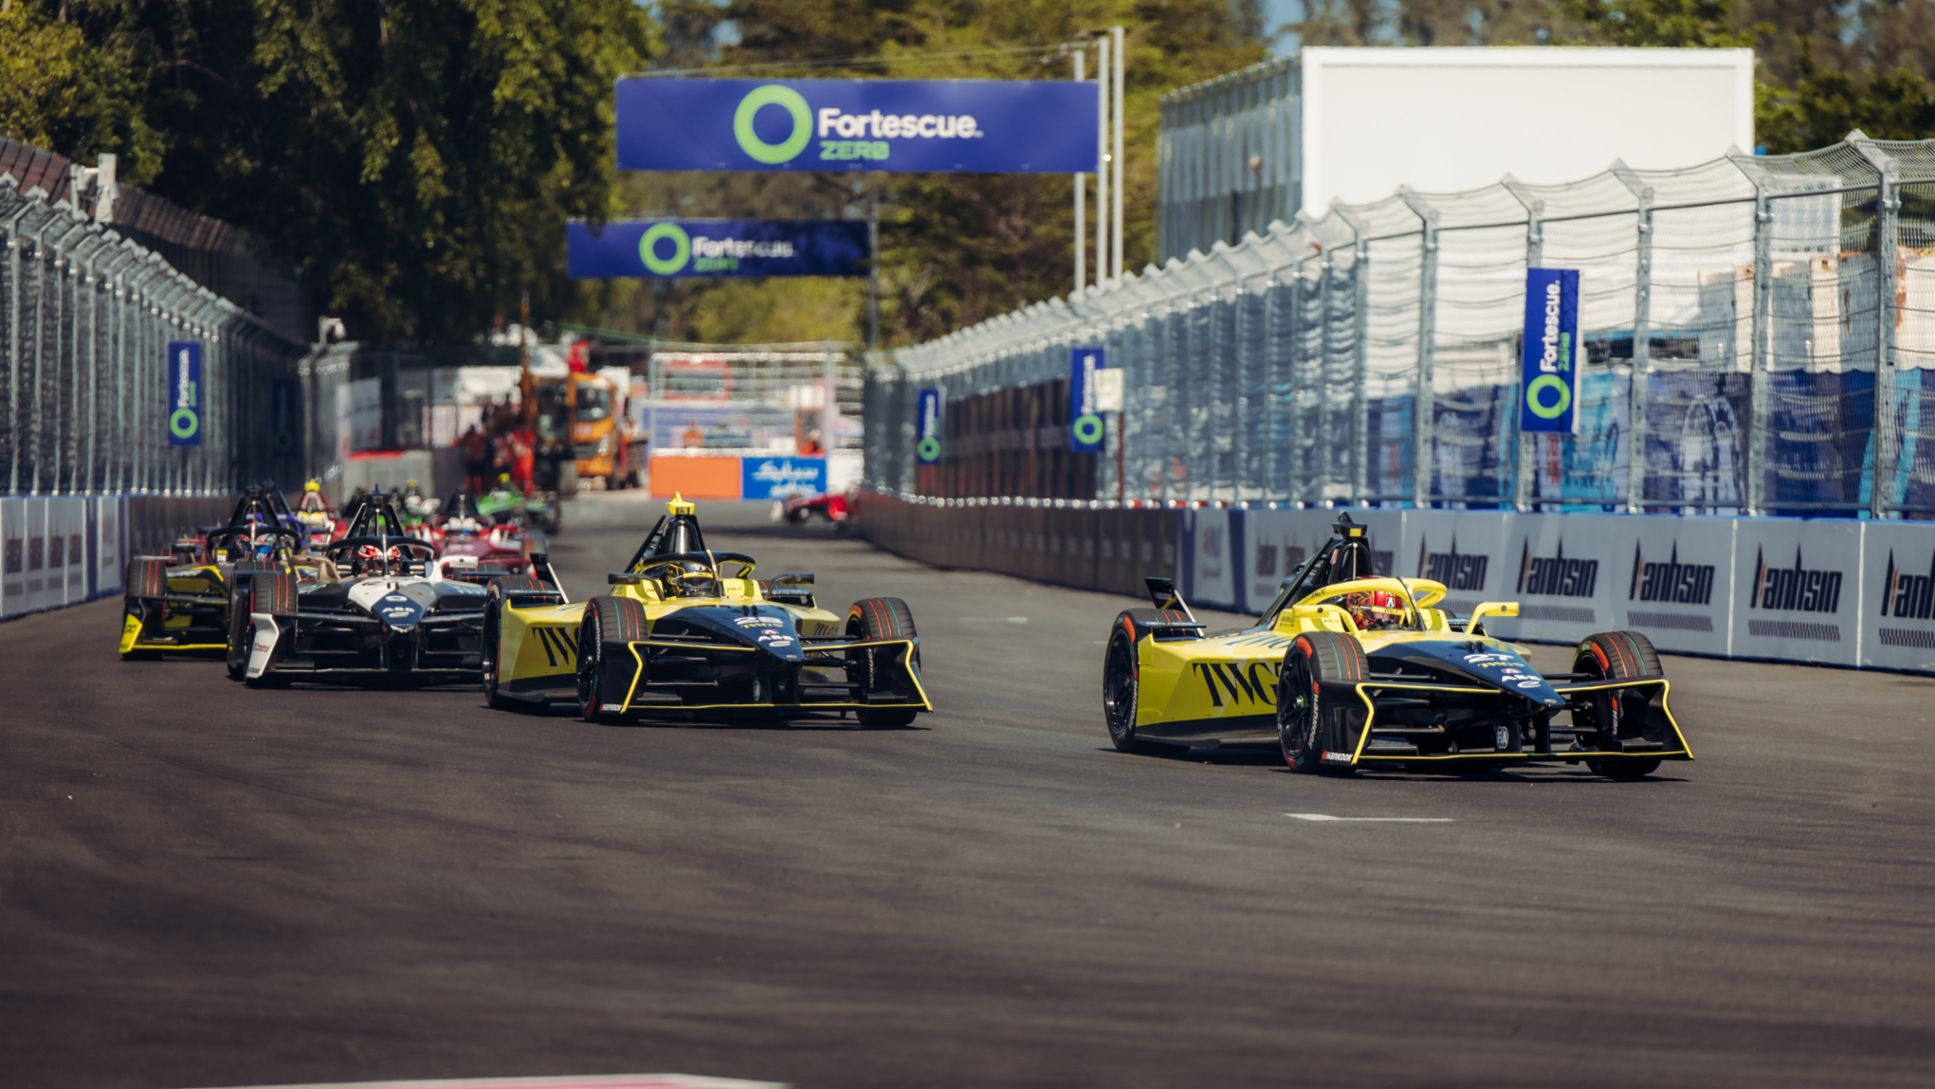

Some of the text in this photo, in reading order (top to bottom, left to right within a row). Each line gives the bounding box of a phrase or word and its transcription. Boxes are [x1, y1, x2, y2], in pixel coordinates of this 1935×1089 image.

[818, 106, 977, 139] Fortescue
[820, 141, 889, 161] ZERO
[1539, 283, 1561, 372] Fortescue
